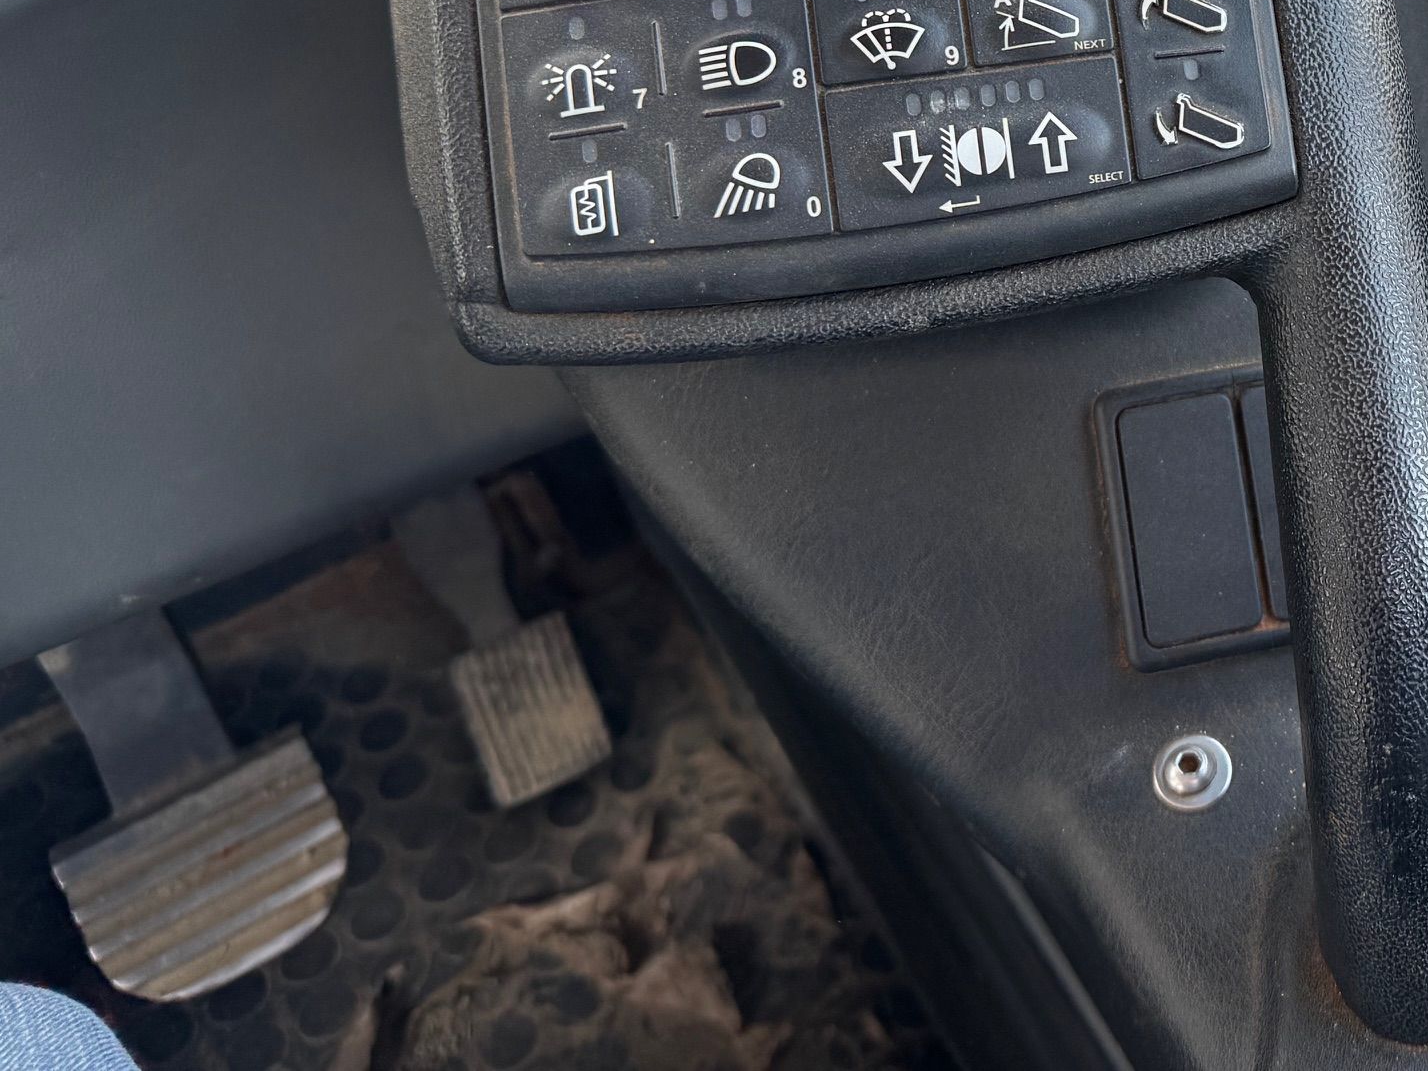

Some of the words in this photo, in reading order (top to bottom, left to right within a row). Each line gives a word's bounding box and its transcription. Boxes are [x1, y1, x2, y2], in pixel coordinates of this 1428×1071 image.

[1074, 39, 1107, 50] NEXT
[945, 46, 960, 66] 9
[792, 68, 808, 89] 8
[632, 88, 648, 109] 7
[1088, 171, 1124, 183] SELECT
[806, 196, 822, 217] 0
